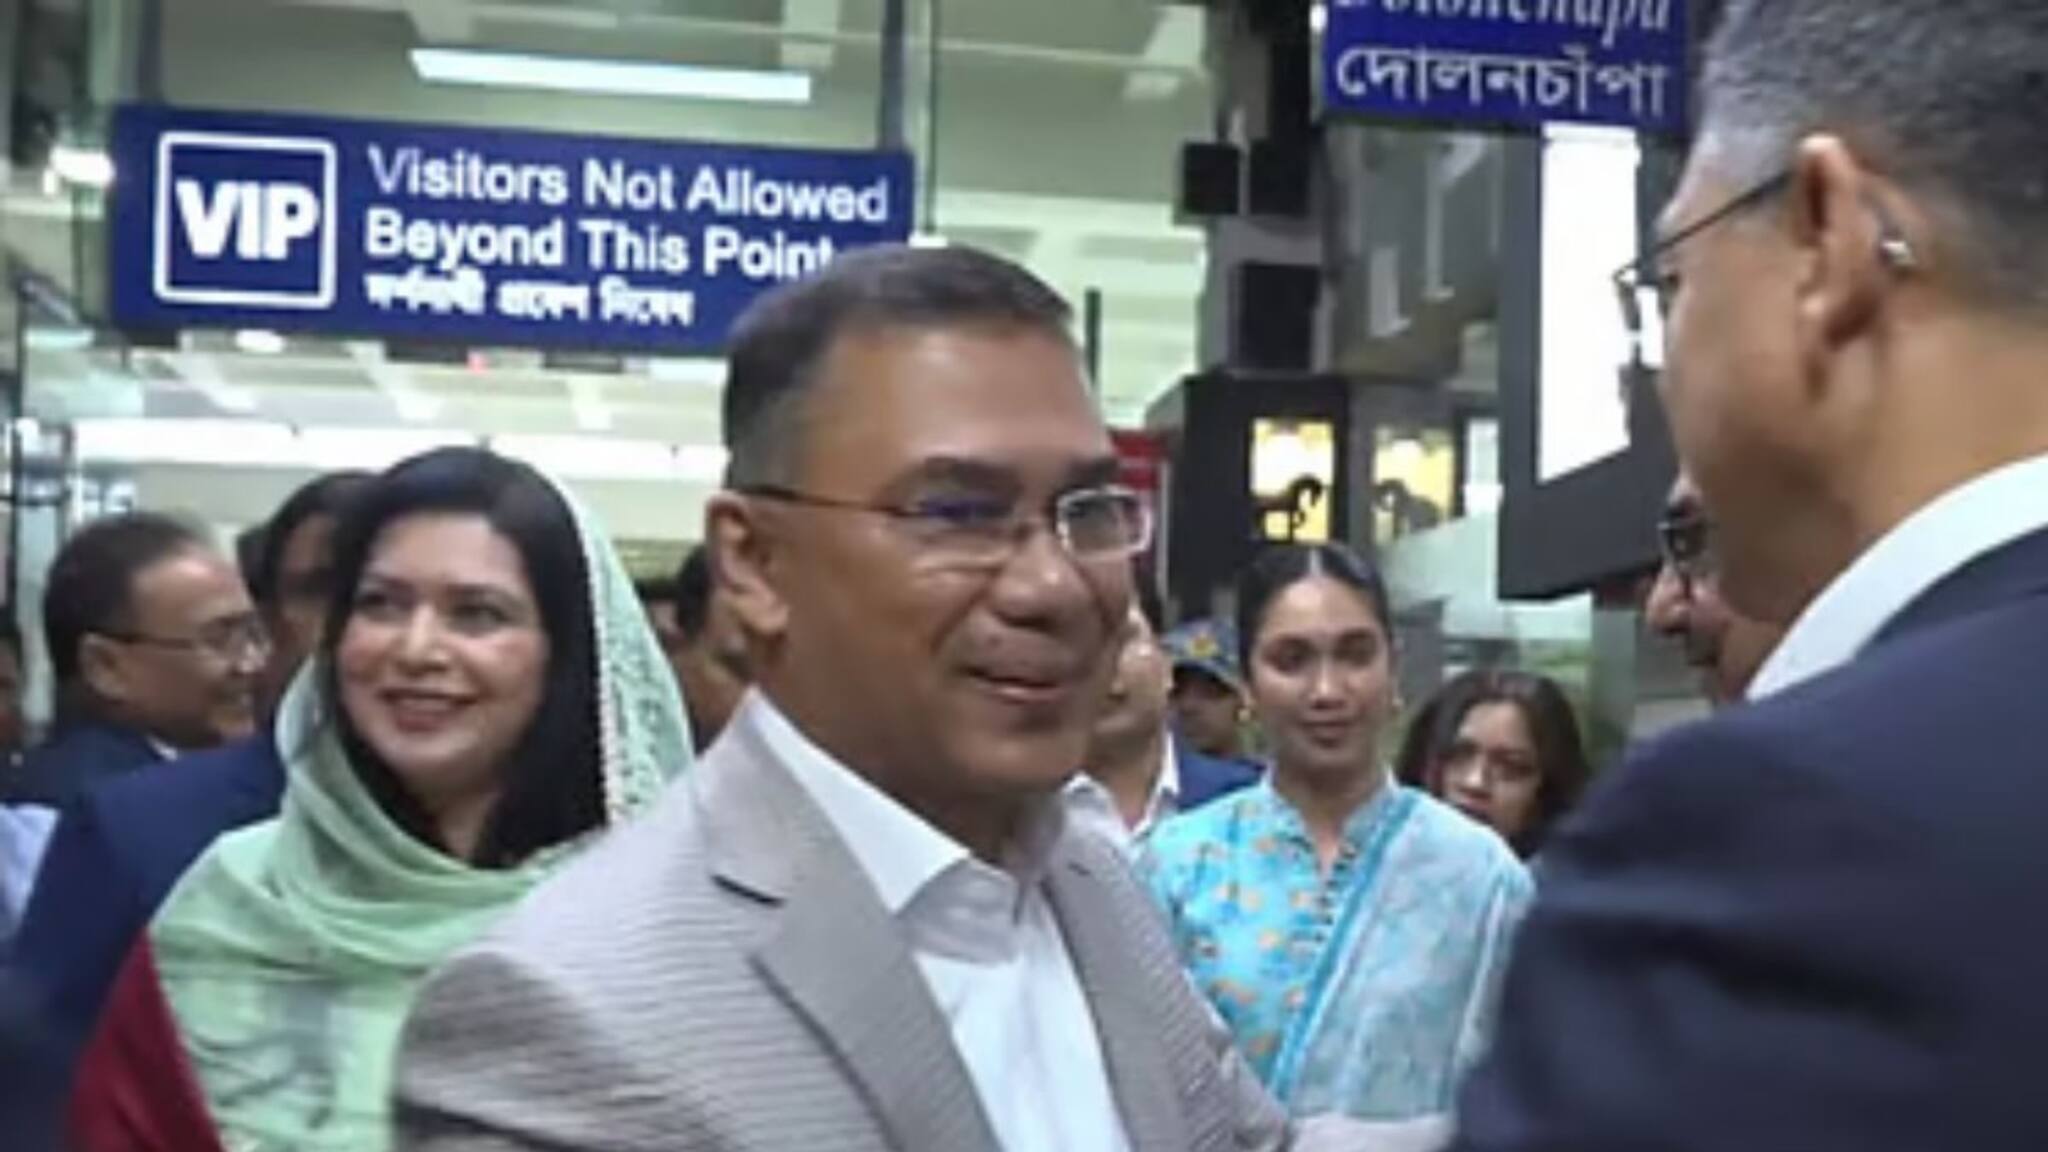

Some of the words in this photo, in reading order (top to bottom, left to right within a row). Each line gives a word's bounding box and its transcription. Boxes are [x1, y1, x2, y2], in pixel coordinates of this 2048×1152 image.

[1335, 0, 1671, 48] onchapa
[1336, 43, 1669, 117] দোলনচাঁপা
[175, 179, 320, 260] VIP
[368, 144, 568, 204] Visitors
[582, 157, 674, 210] Not
[687, 164, 889, 222] Allowed
[366, 206, 565, 271] Beyond
[578, 218, 690, 274] This
[704, 225, 834, 280] Point
